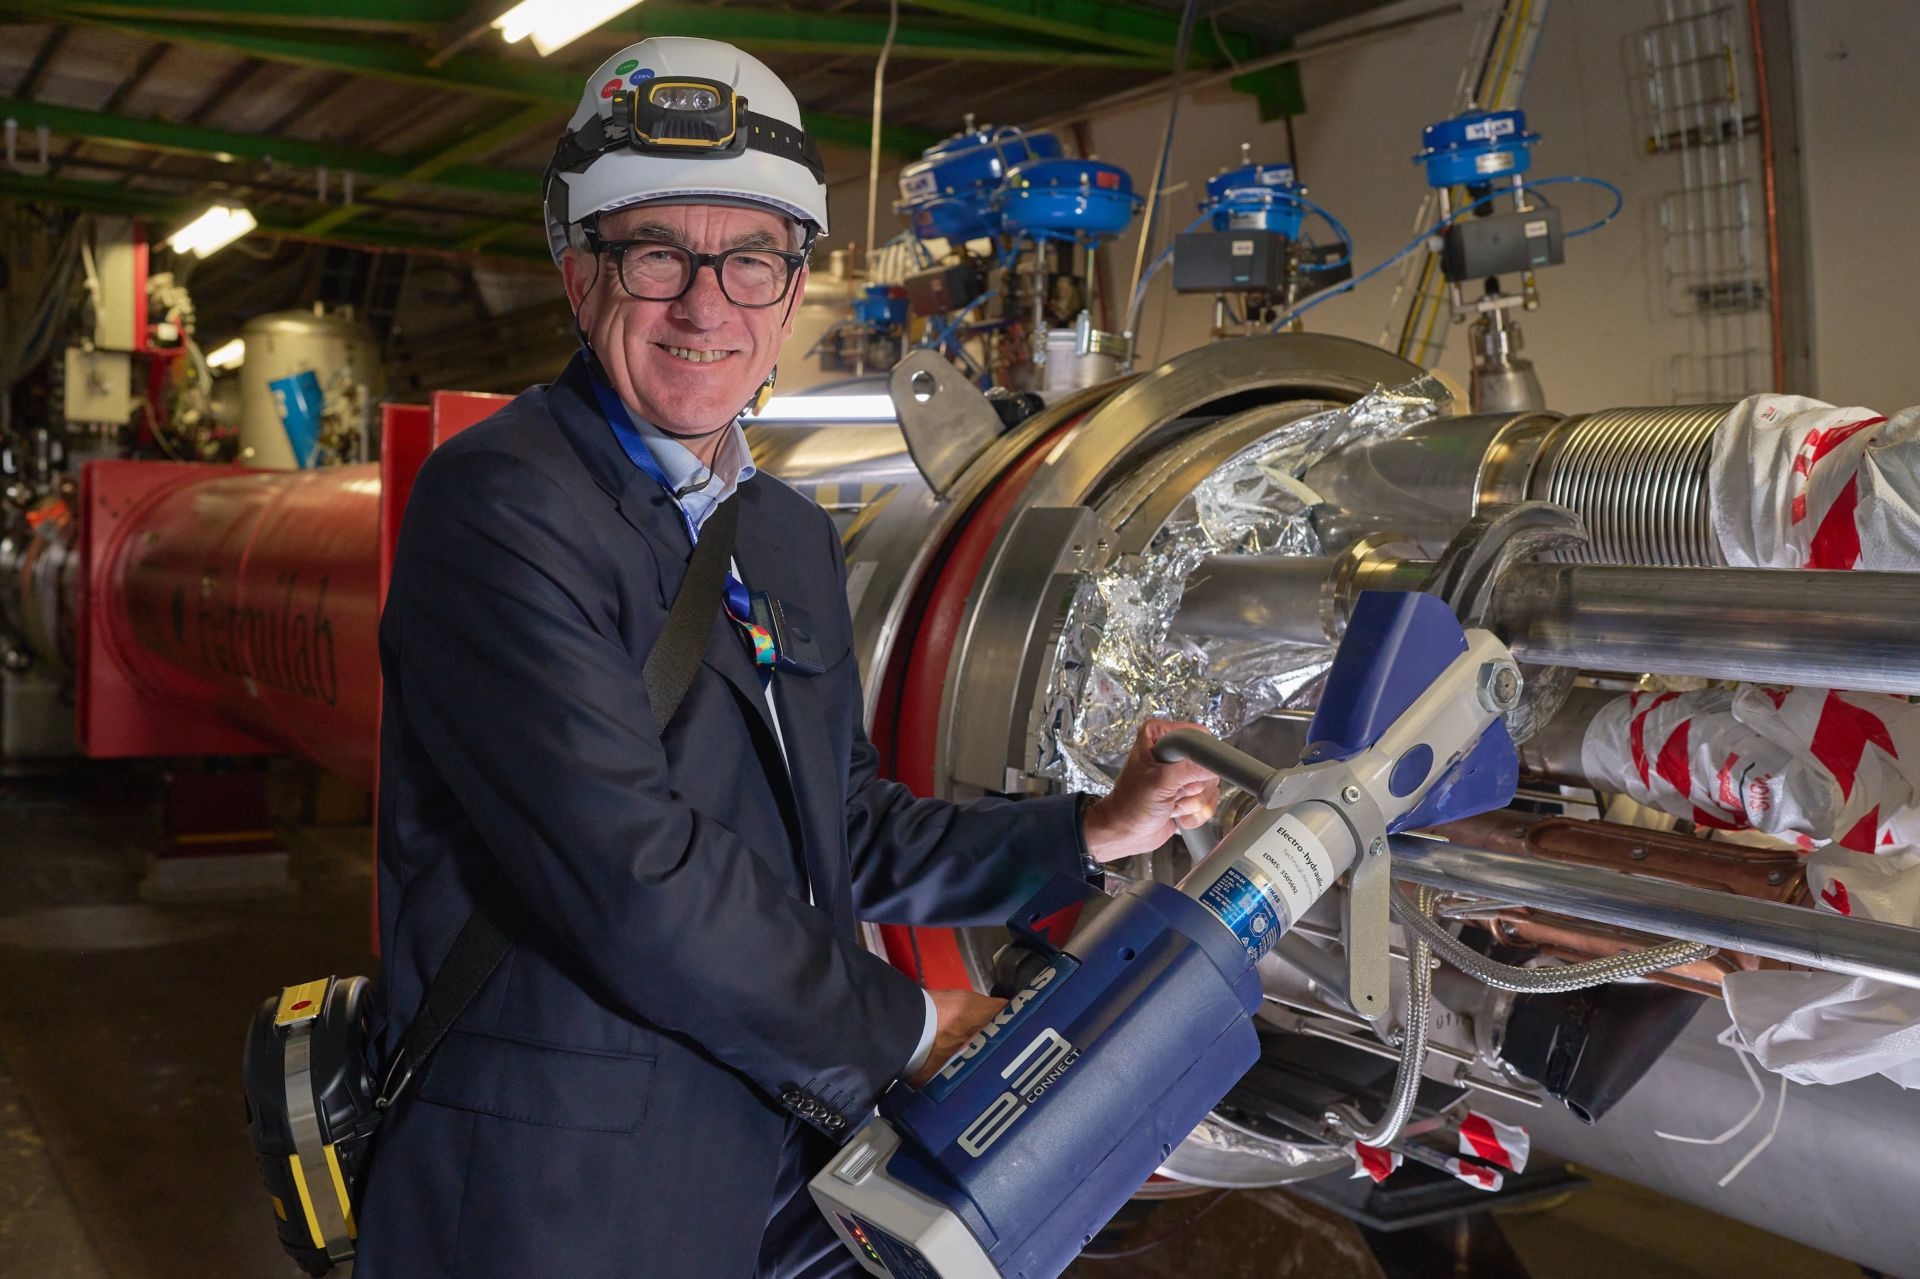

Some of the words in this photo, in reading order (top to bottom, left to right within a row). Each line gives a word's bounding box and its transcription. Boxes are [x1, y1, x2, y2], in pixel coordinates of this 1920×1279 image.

[1262, 852, 1281, 871] EDMS:
[1279, 868, 1298, 895] 3505692
[1276, 826, 1324, 889] Electro-hydraulic
[1263, 882, 1281, 904] LUKAS
[942, 966, 1057, 1080] LUKAS
[1026, 1048, 1080, 1104] CONNECT
